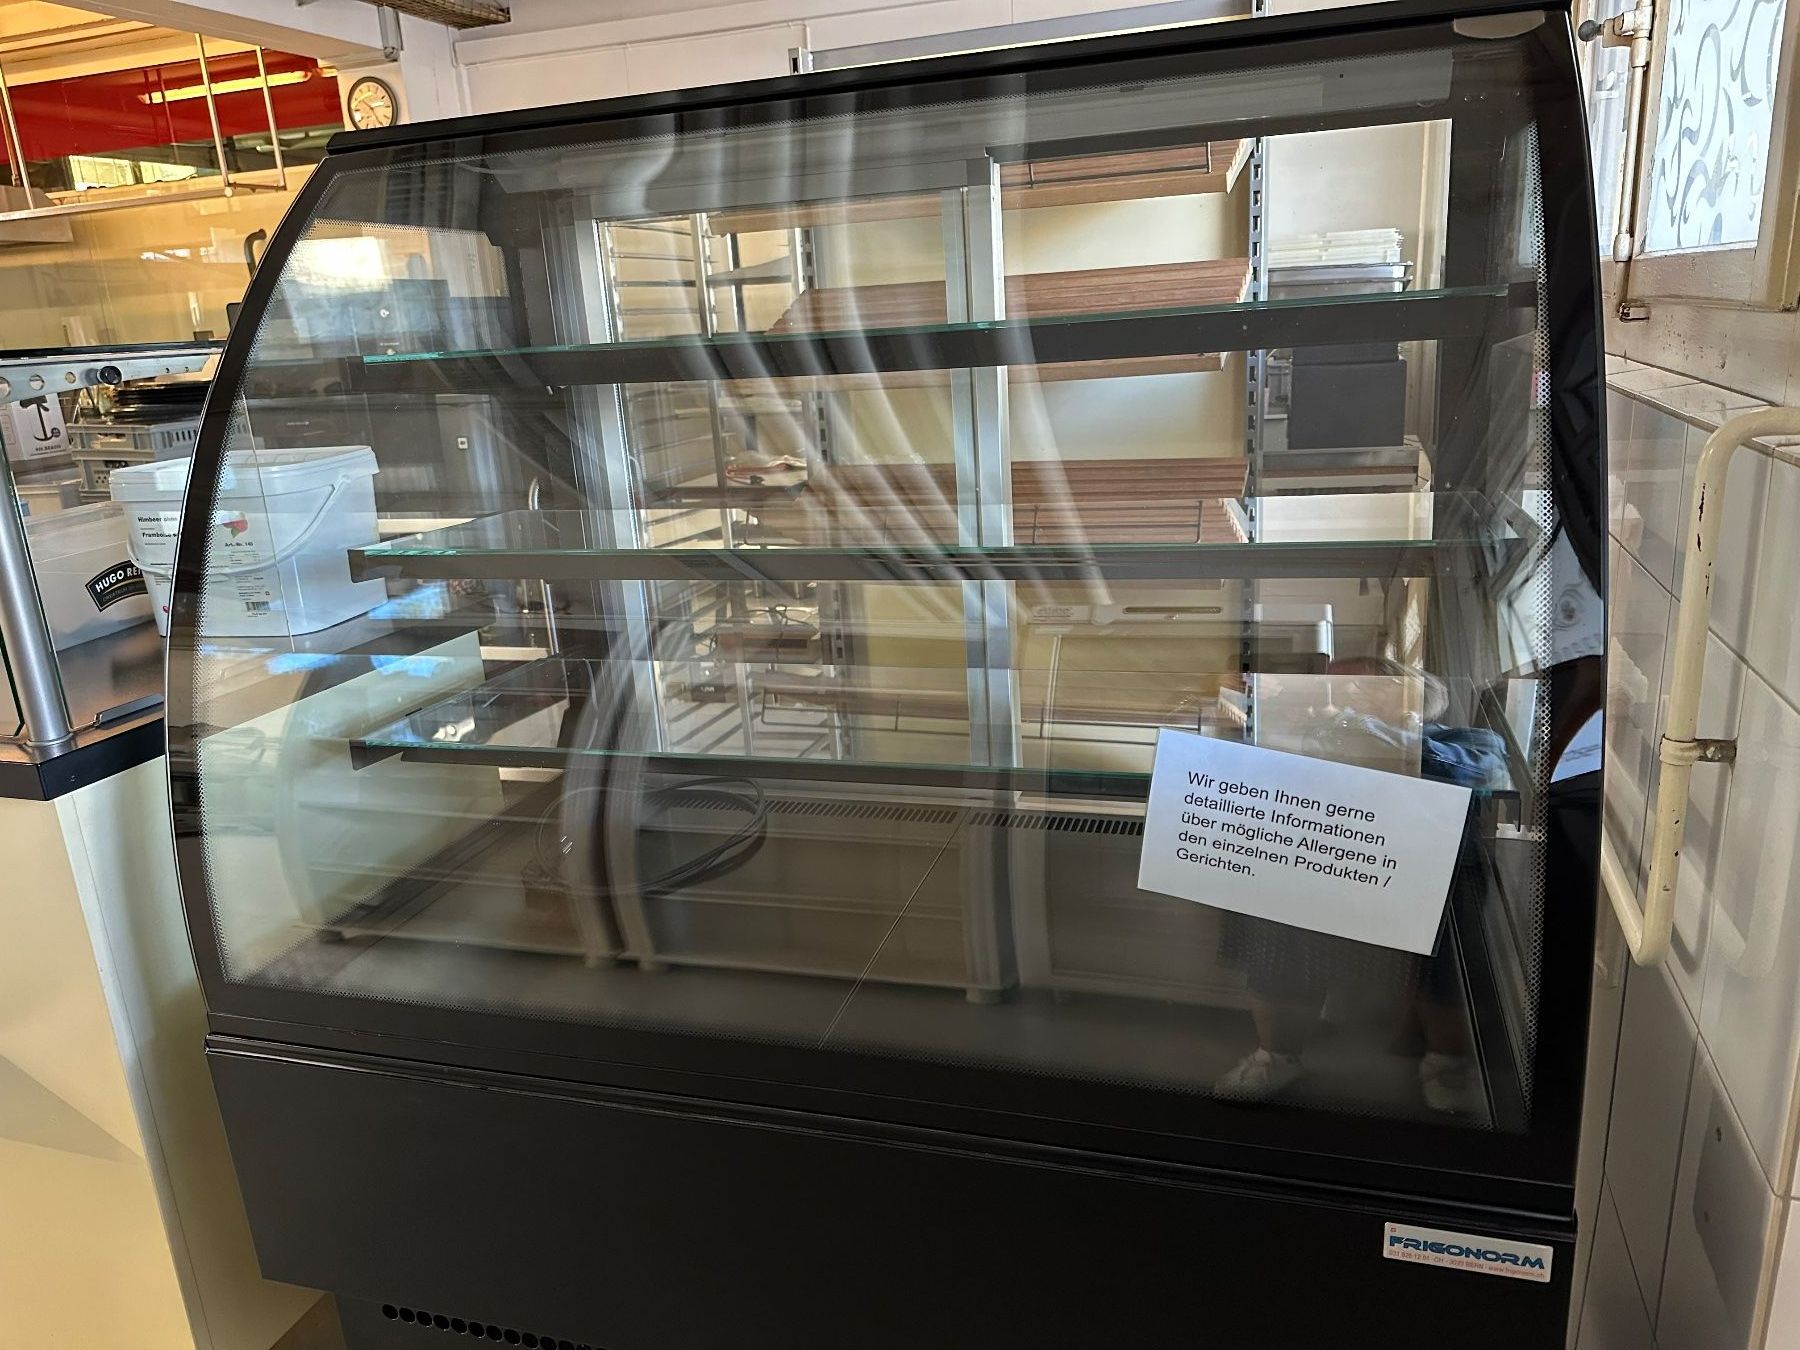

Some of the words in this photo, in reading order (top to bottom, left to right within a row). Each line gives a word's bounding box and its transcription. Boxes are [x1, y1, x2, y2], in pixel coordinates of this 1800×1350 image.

[95, 570, 124, 593] HUGO
[1184, 792, 1266, 820] detaillierte
[1271, 810, 1385, 846] Informationen
[1188, 771, 1215, 788] Wir
[1219, 781, 1269, 800] geben
[1274, 789, 1321, 811] Ihnen
[1326, 803, 1376, 822] gerne
[1176, 848, 1255, 876] Gerichten.
[1178, 830, 1207, 846] den
[1212, 839, 1289, 865] einzelnen
[1294, 856, 1379, 885] Produkten
[1383, 876, 1392, 888] /
[1181, 811, 1218, 829] über
[1221, 822, 1294, 847] mögliche
[1297, 837, 1377, 865] Allergene
[1382, 854, 1397, 870] in
[1389, 1236, 1545, 1269] FRIGONORM
